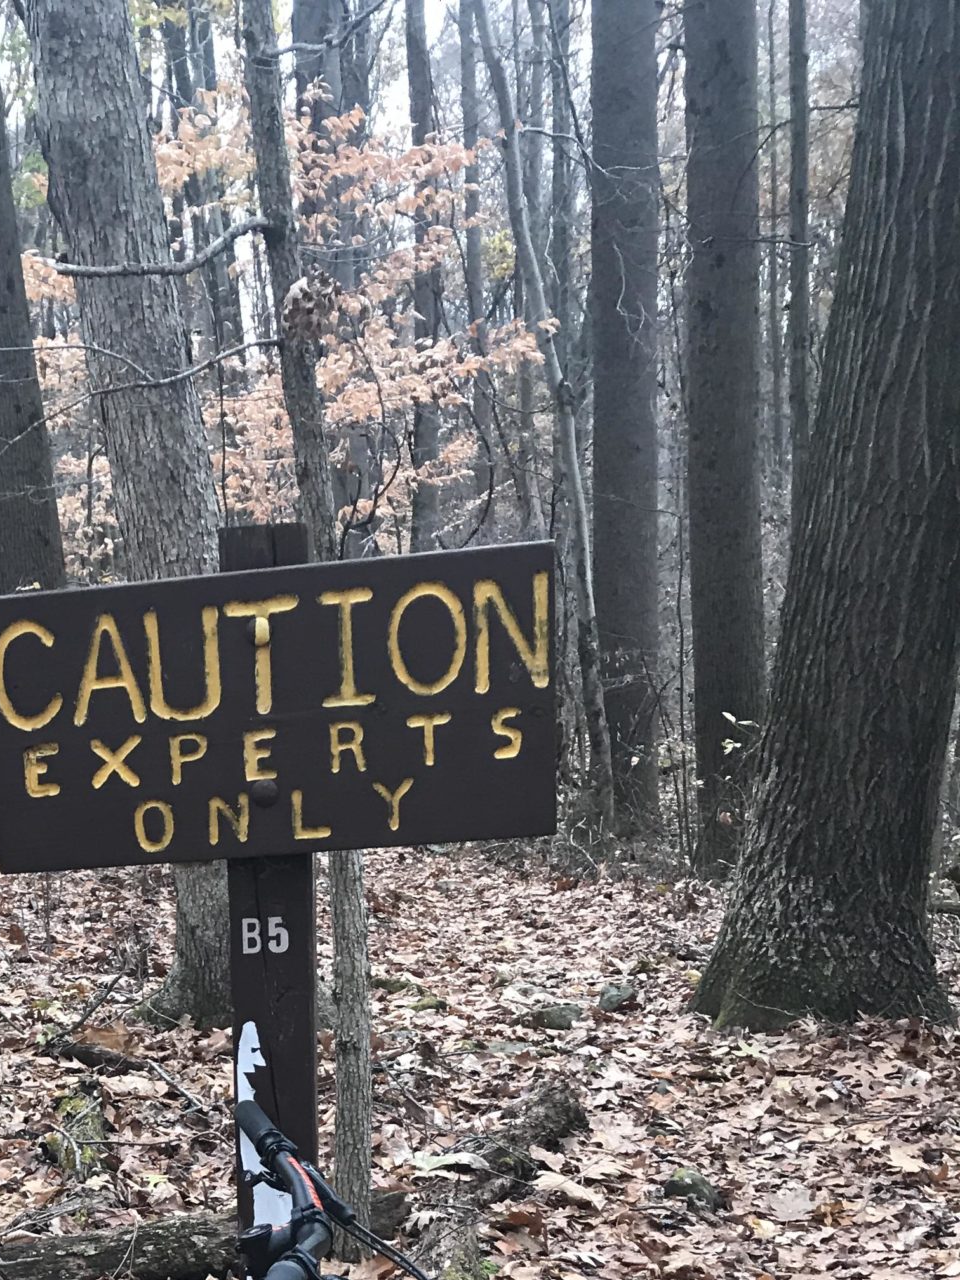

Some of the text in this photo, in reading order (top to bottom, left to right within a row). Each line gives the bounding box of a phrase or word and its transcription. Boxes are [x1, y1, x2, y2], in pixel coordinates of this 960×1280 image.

[24, 707, 522, 797] EXPERTS
[134, 777, 414, 852] ONLY
[241, 916, 289, 954] B5
